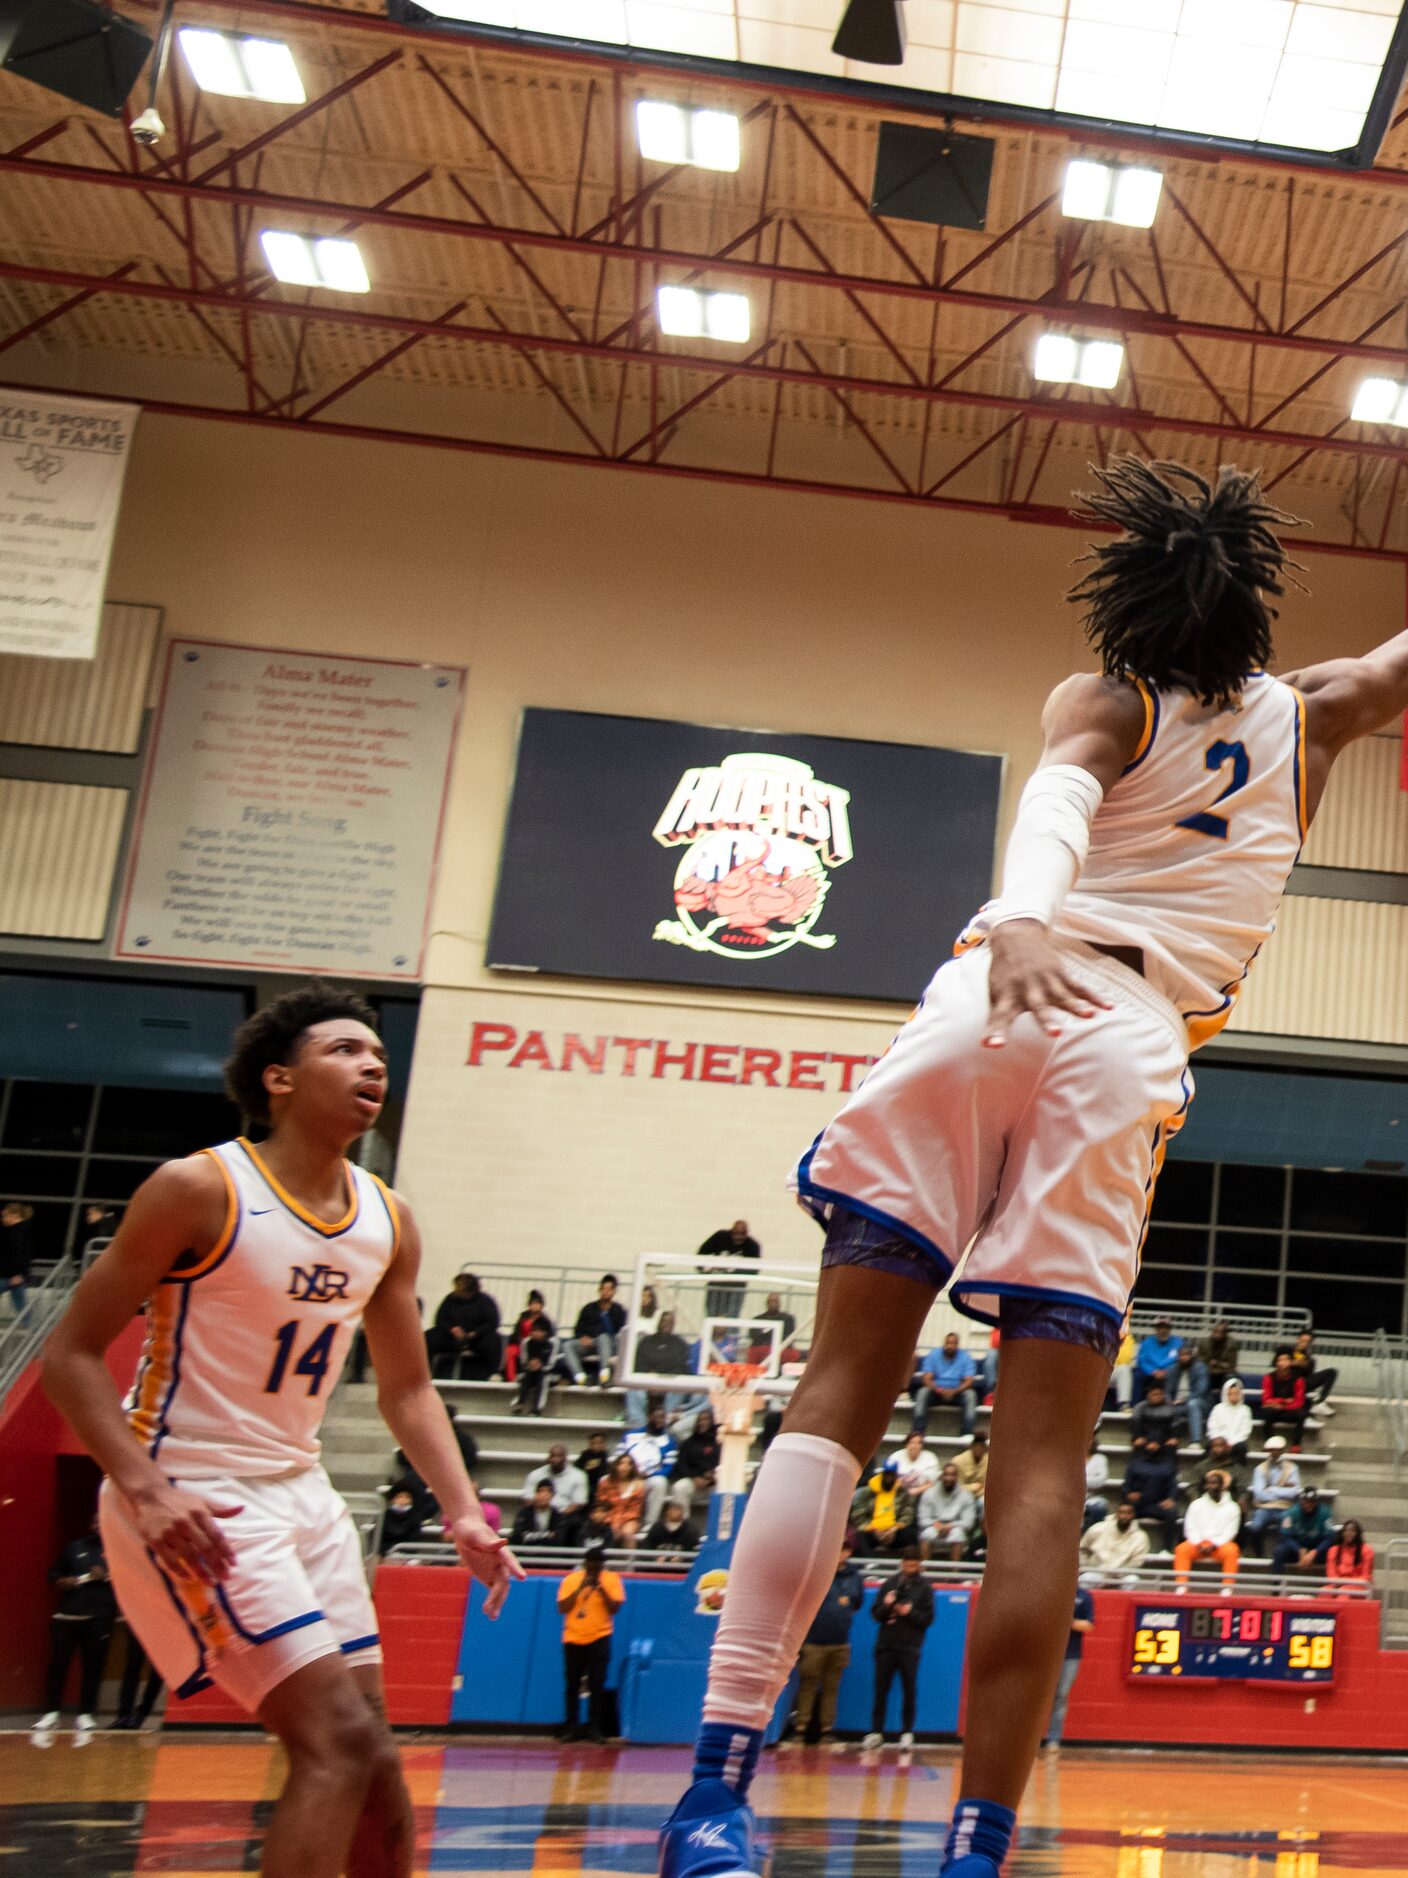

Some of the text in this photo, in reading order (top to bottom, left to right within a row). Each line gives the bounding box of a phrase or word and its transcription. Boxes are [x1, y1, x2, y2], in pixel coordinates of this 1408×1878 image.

[32, 428, 51, 438] OF
[57, 428, 125, 451] FAME
[47, 412, 122, 433] SPORTS
[263, 663, 375, 689] Alma Mater
[1174, 738, 1251, 842] 2
[241, 806, 349, 835] Fight Song
[652, 766, 854, 869] HOOPFEST
[264, 1319, 339, 1396] 14
[1134, 1629, 1334, 1669] 53 58
